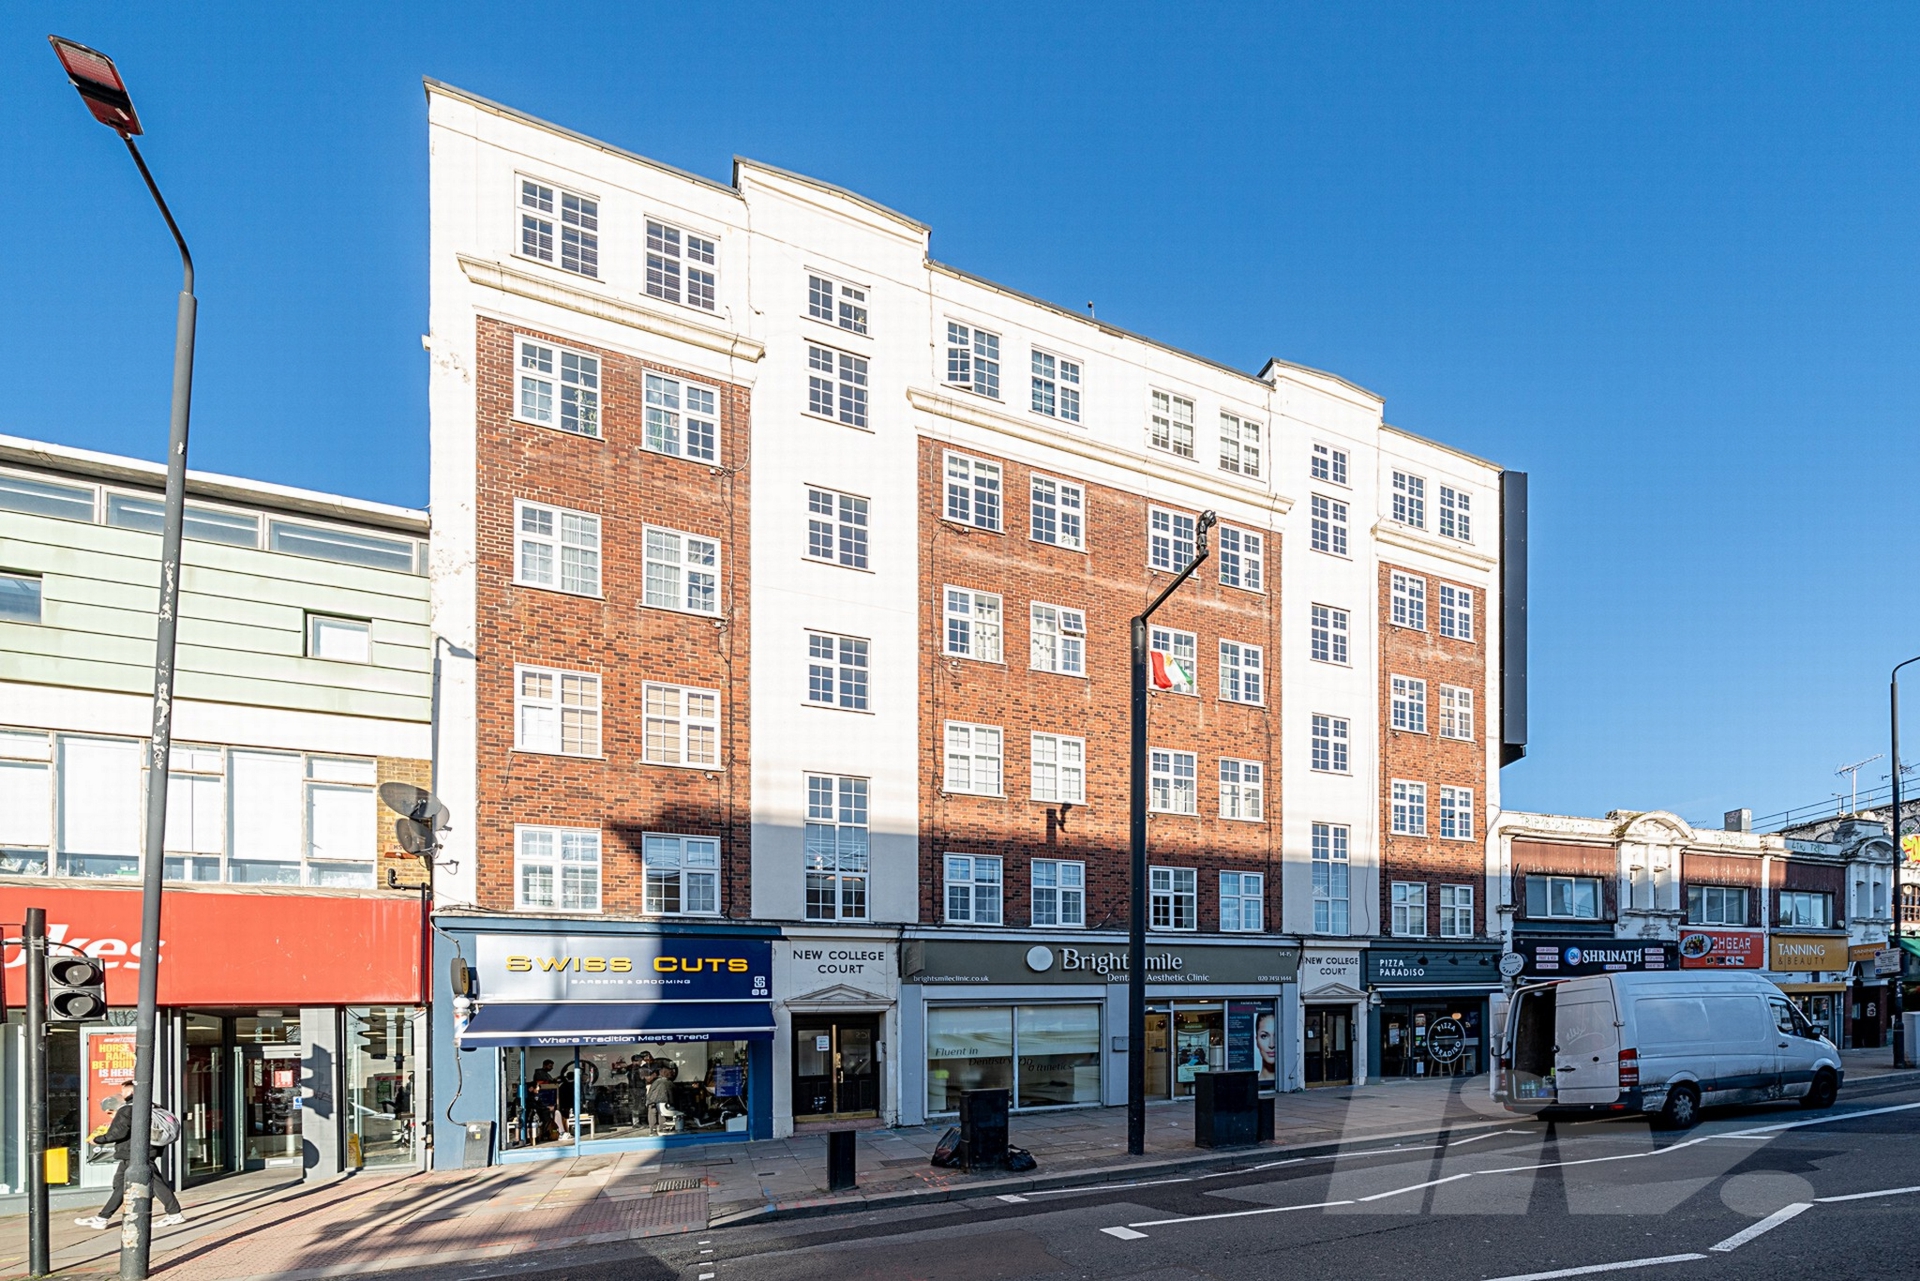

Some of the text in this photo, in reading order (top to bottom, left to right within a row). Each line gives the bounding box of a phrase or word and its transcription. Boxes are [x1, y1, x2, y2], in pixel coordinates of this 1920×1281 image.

[1778, 944, 1826, 956] TANNING
[793, 950, 885, 961] NEW COLLEGE
[1582, 948, 1642, 964] SHRINATH
[505, 955, 749, 973] SWISS CUTS
[1060, 947, 1183, 974] Brightmile
[1305, 957, 1359, 965] NEW COLLEGE
[1379, 959, 1404, 967] PIZZA
[1778, 957, 1826, 965] & BEAUTY
[817, 964, 864, 974] COURT
[1320, 967, 1347, 975] COURT
[1379, 968, 1425, 976] PARADISO
[1146, 974, 1185, 982] Aesthetic
[1187, 974, 1210, 982] Clinic
[1437, 1022, 1456, 1032] PIZZA
[99, 1043, 129, 1053] HORSE
[935, 1047, 978, 1056] Fluent in
[1433, 1041, 1461, 1057] PARADISO
[92, 1061, 110, 1069] BET
[969, 1057, 1012, 1066] Dentistry
[99, 1069, 134, 1077] IS HERE
